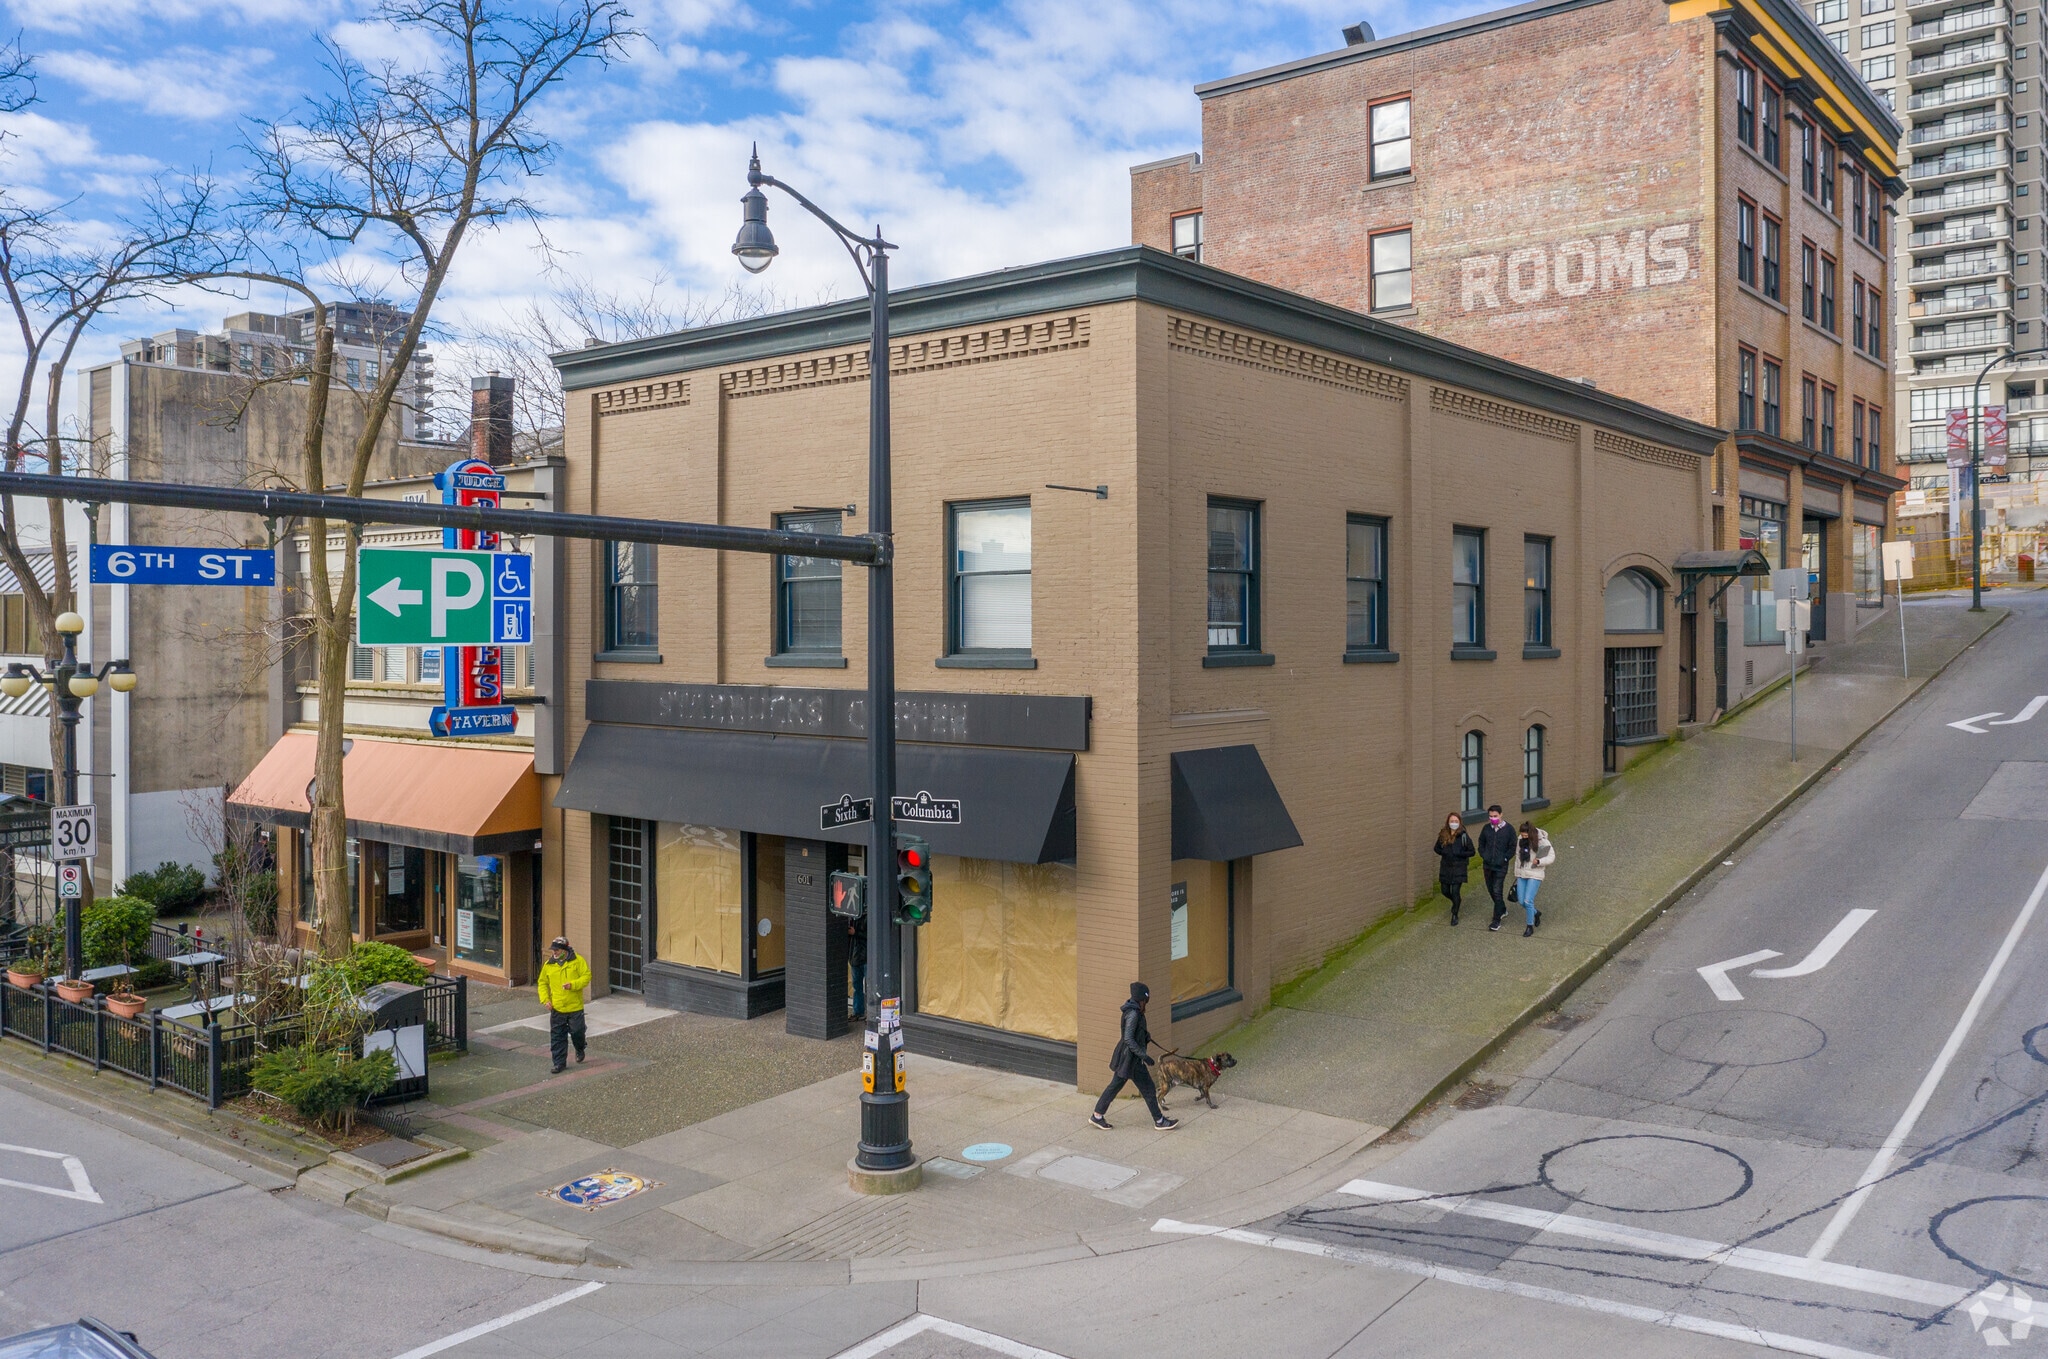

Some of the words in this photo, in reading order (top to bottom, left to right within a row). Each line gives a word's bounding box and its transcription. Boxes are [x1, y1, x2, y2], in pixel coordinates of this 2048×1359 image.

[457, 475, 502, 488] JUDGE
[107, 551, 175, 577] 6TH
[198, 554, 261, 580] ST.
[431, 558, 485, 637] P
[452, 713, 512, 729] TAVERN
[56, 808, 92, 819] MAXIMUM
[835, 805, 857, 823] Sixth
[902, 802, 953, 819] Columbia
[58, 819, 91, 847] 30
[63, 846, 86, 856] km/h
[797, 874, 810, 885] 601
